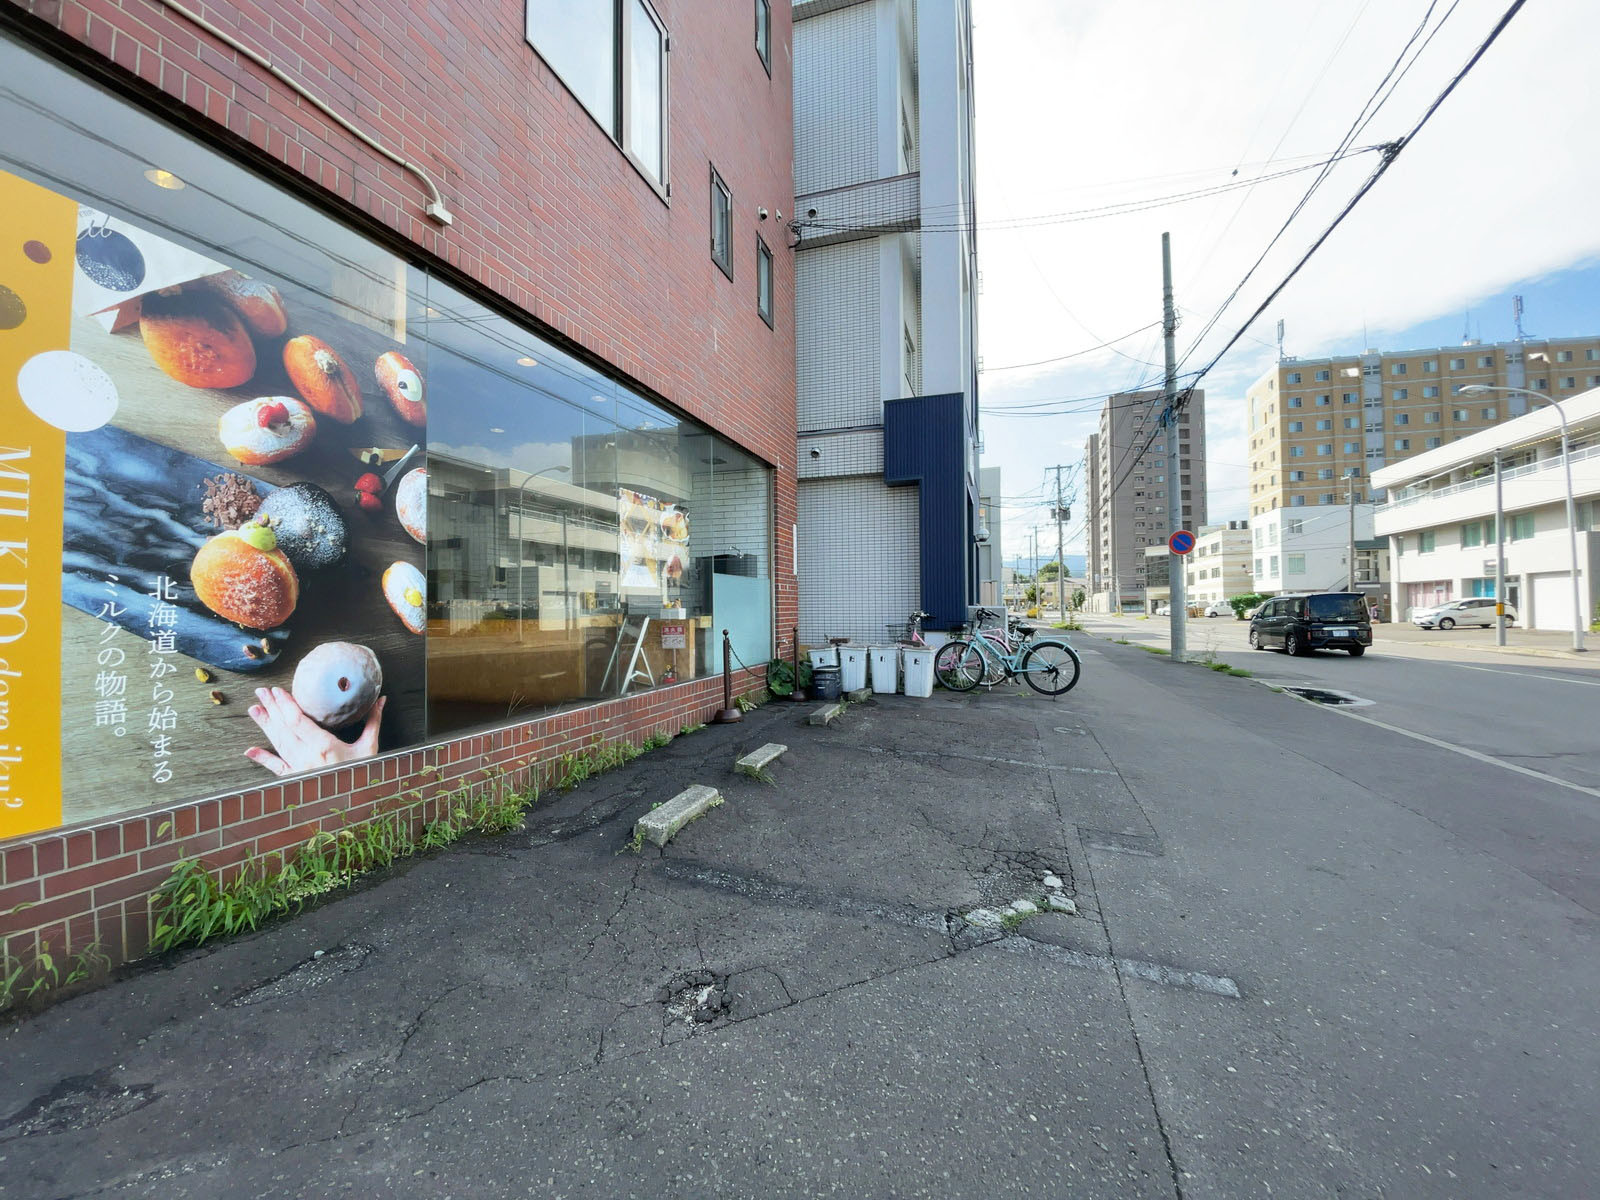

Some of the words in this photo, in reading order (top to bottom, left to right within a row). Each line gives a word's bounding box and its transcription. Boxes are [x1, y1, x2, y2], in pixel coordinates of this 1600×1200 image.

[94, 573, 128, 738] ミルクの物語。
[147, 575, 179, 784] 北海道から始まる
